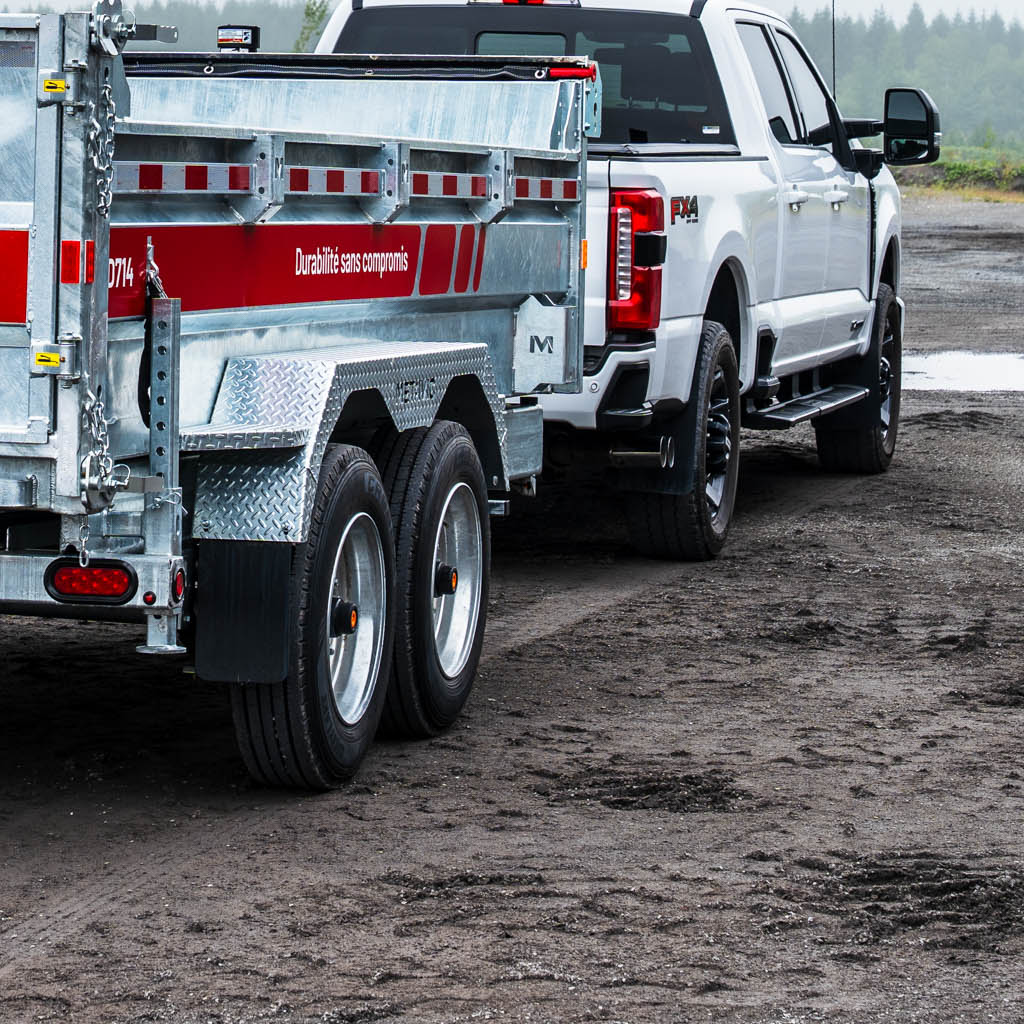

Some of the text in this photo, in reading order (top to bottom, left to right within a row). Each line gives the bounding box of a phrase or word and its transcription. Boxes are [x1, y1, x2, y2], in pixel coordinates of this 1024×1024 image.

[670, 195, 698, 225] FX4
[295, 245, 408, 279] Durabilité sans compromis
[529, 335, 554, 354] M
